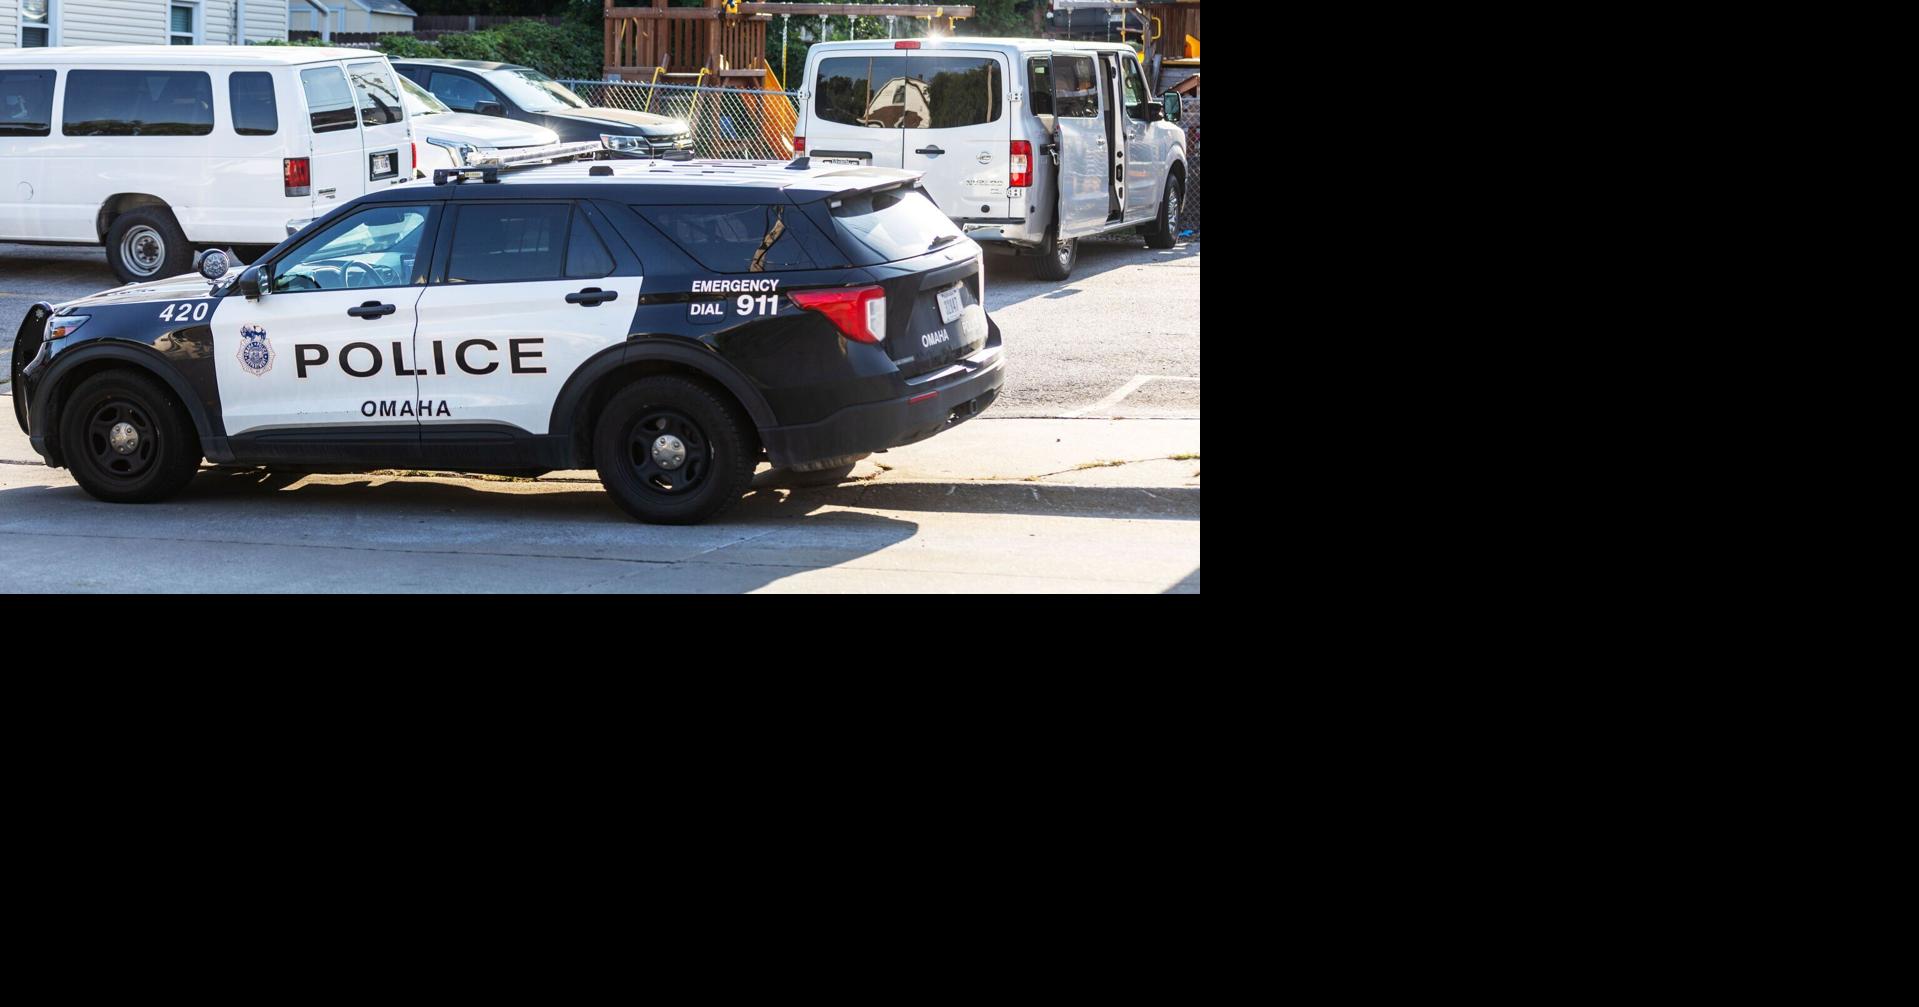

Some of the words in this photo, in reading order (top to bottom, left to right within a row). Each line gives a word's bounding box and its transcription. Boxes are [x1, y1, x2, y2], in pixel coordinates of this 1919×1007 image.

[692, 279, 779, 292] EMERGENCY
[159, 303, 209, 321] 420
[690, 304, 724, 315] DIAL
[736, 295, 778, 316] 911
[921, 329, 950, 348] OMAHA
[294, 337, 547, 379] POLICE
[361, 400, 451, 417] OMAHA
